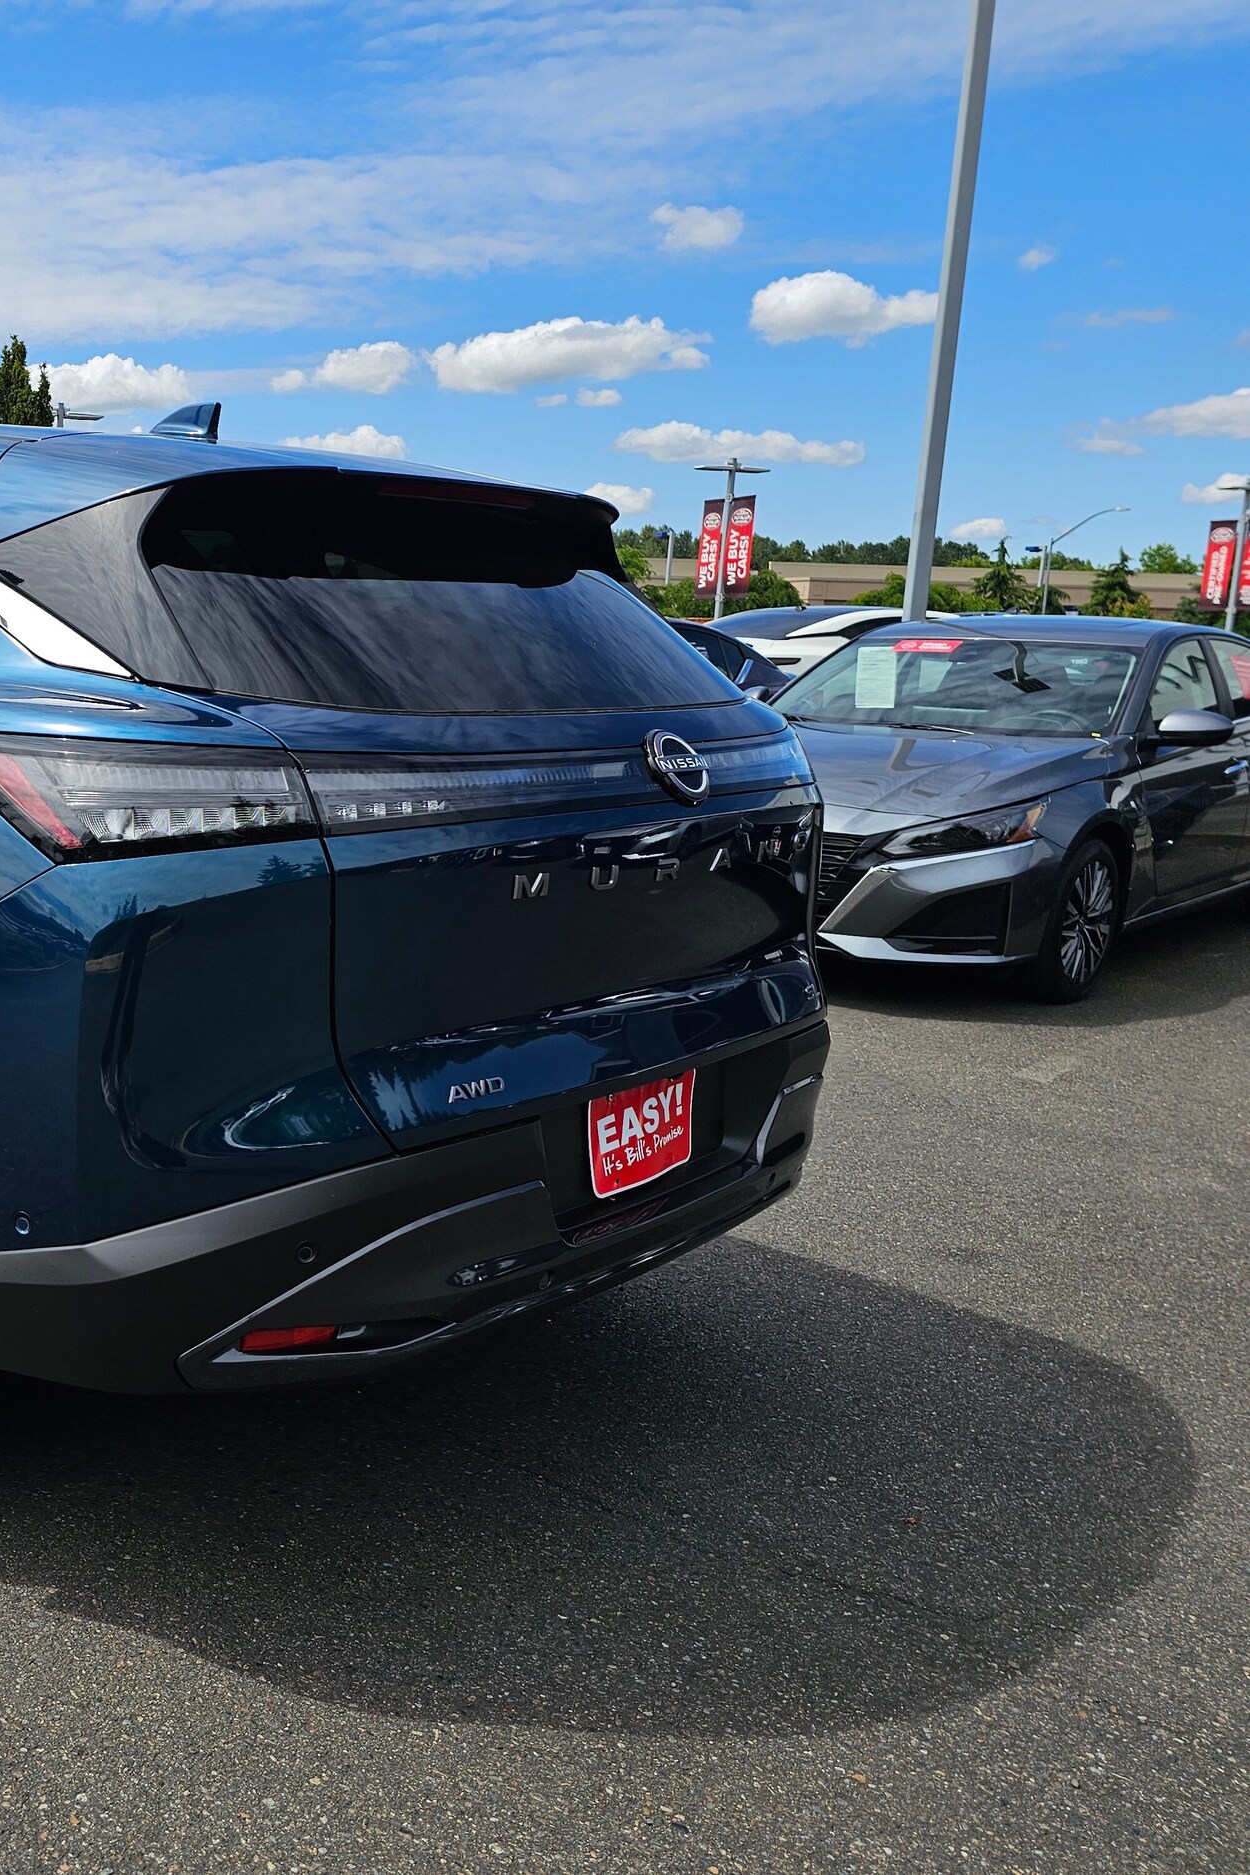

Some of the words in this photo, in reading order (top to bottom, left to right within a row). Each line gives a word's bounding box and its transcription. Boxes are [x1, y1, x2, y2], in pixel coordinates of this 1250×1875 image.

[701, 533, 711, 563] BUY
[728, 529, 740, 559] BUY
[737, 535, 749, 578] CARS!
[707, 539, 718, 582] CARS!
[727, 562, 736, 585] WE
[698, 566, 707, 588] WE
[659, 757, 708, 770] NISSAN
[448, 1076, 505, 1104] AWD
[596, 1082, 683, 1155] EASY!
[603, 1154, 623, 1176] It's
[624, 1139, 652, 1166] Bill's
[653, 1125, 684, 1153] Promise
